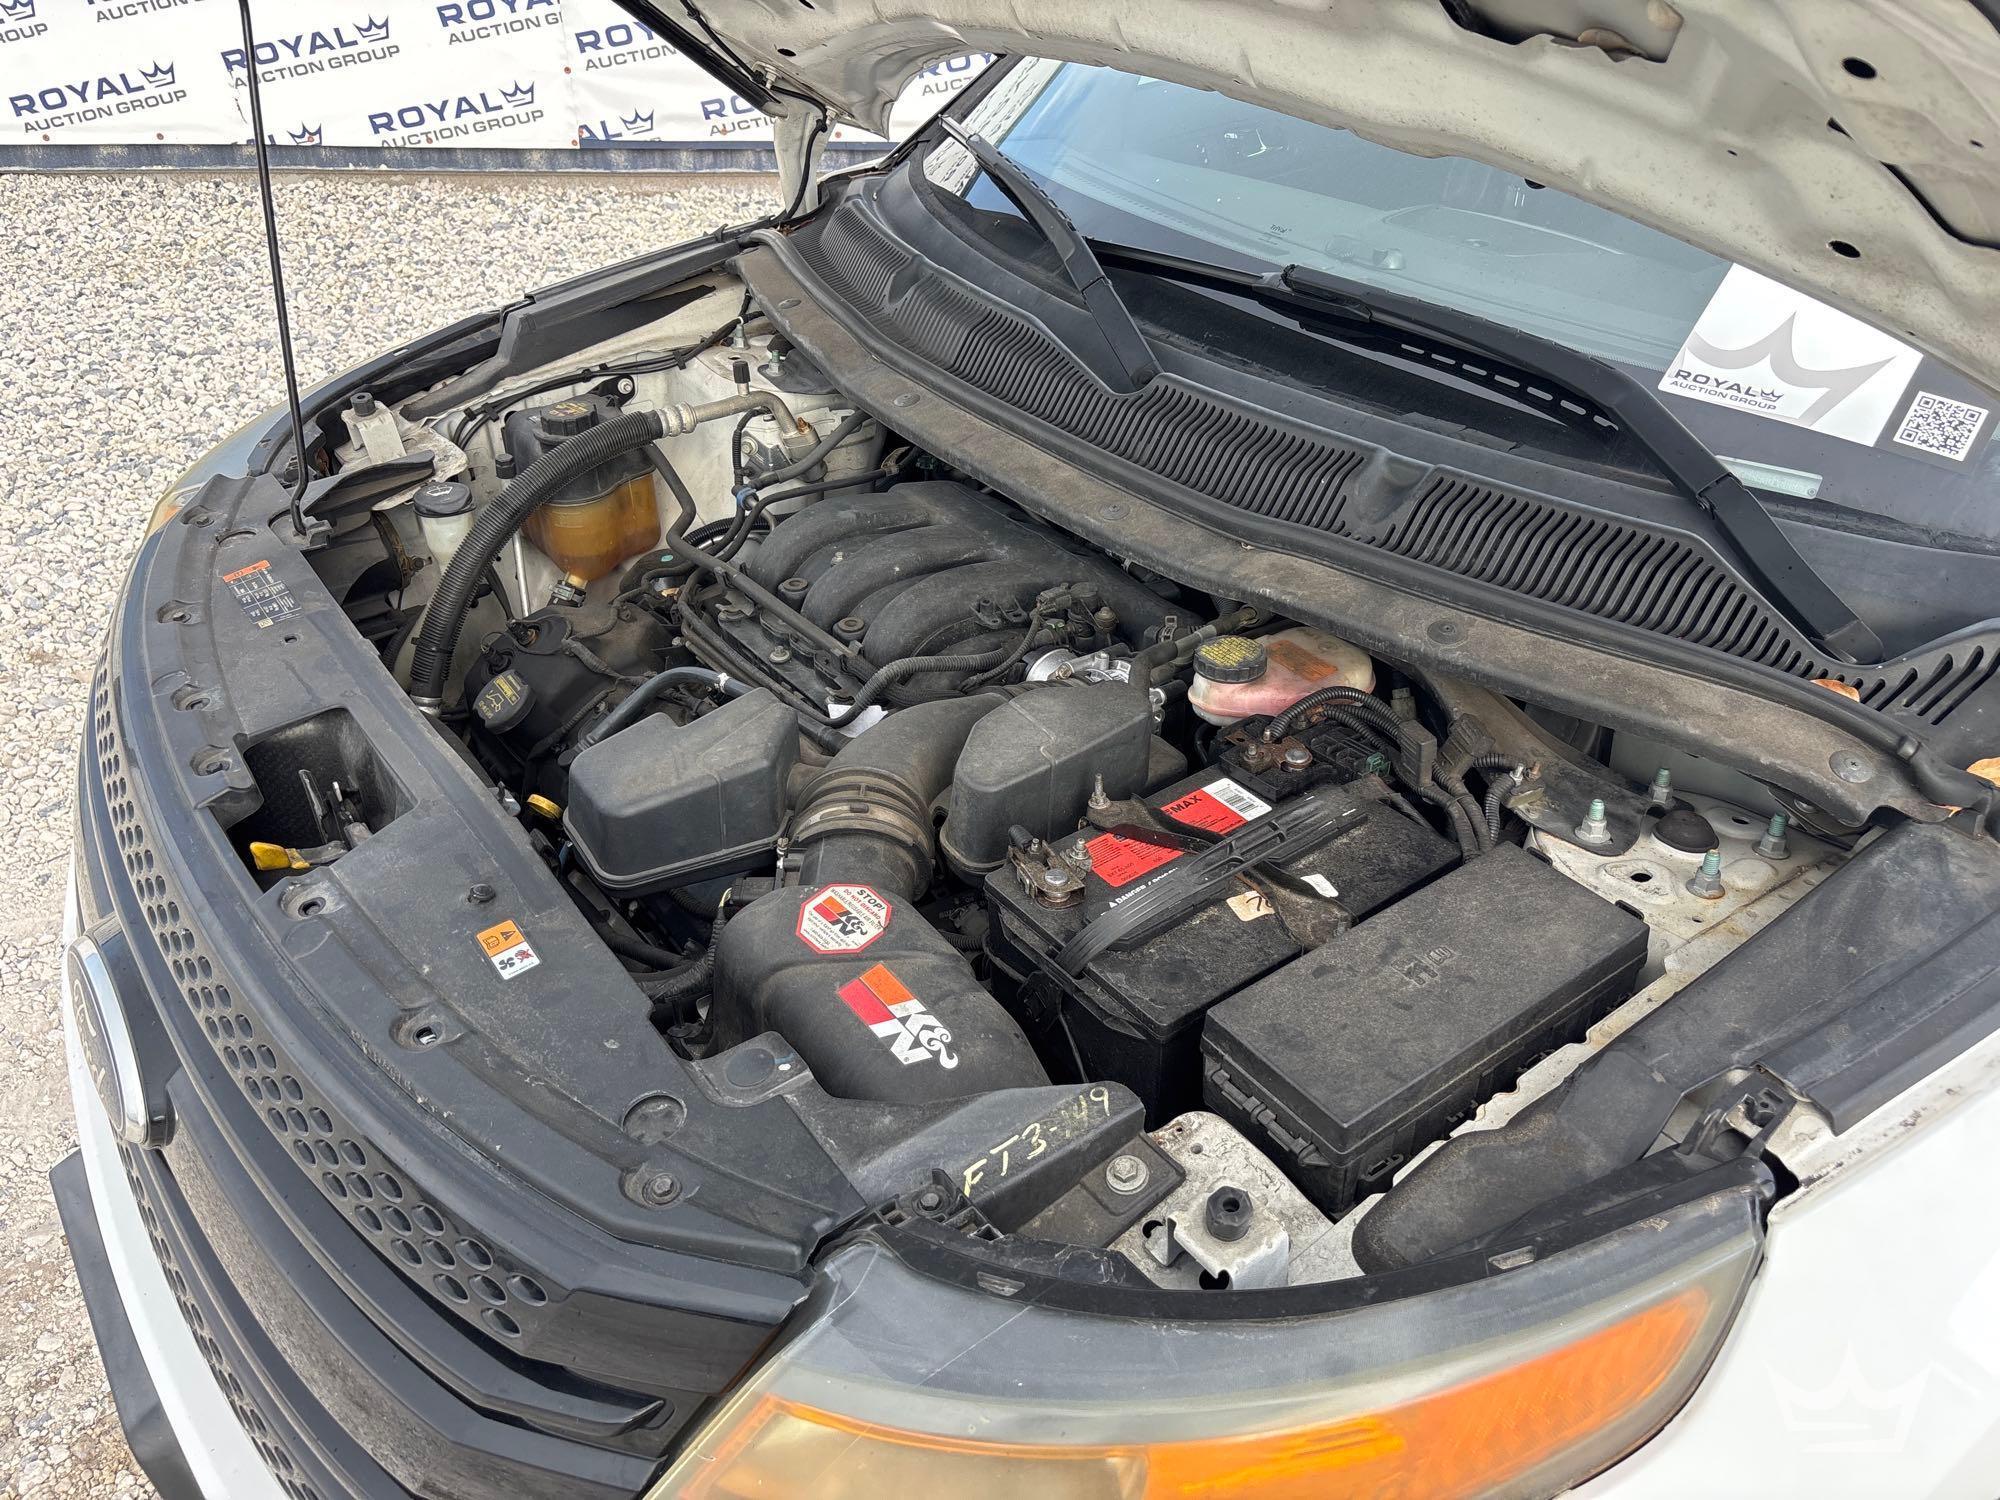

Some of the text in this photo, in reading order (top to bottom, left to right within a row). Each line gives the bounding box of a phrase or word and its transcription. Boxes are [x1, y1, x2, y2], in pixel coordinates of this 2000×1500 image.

[436, 0, 560, 27] ROY
[448, 15, 541, 45] AUCTION
[221, 27, 358, 73] ROYAL
[234, 44, 400, 89] ACTION GROUP
[9, 73, 146, 117] ROYAL
[24, 89, 187, 133] AUCTION GROUP
[368, 92, 504, 135] ROYAL
[381, 109, 544, 148] AUCTION GROUP
[1670, 380, 1777, 411] AUCTION GROUP
[1674, 369, 1757, 397] ROYAL
[1170, 795, 1202, 813] MAX
[857, 889, 885, 912] STOP!
[868, 998, 959, 1070] K&N
